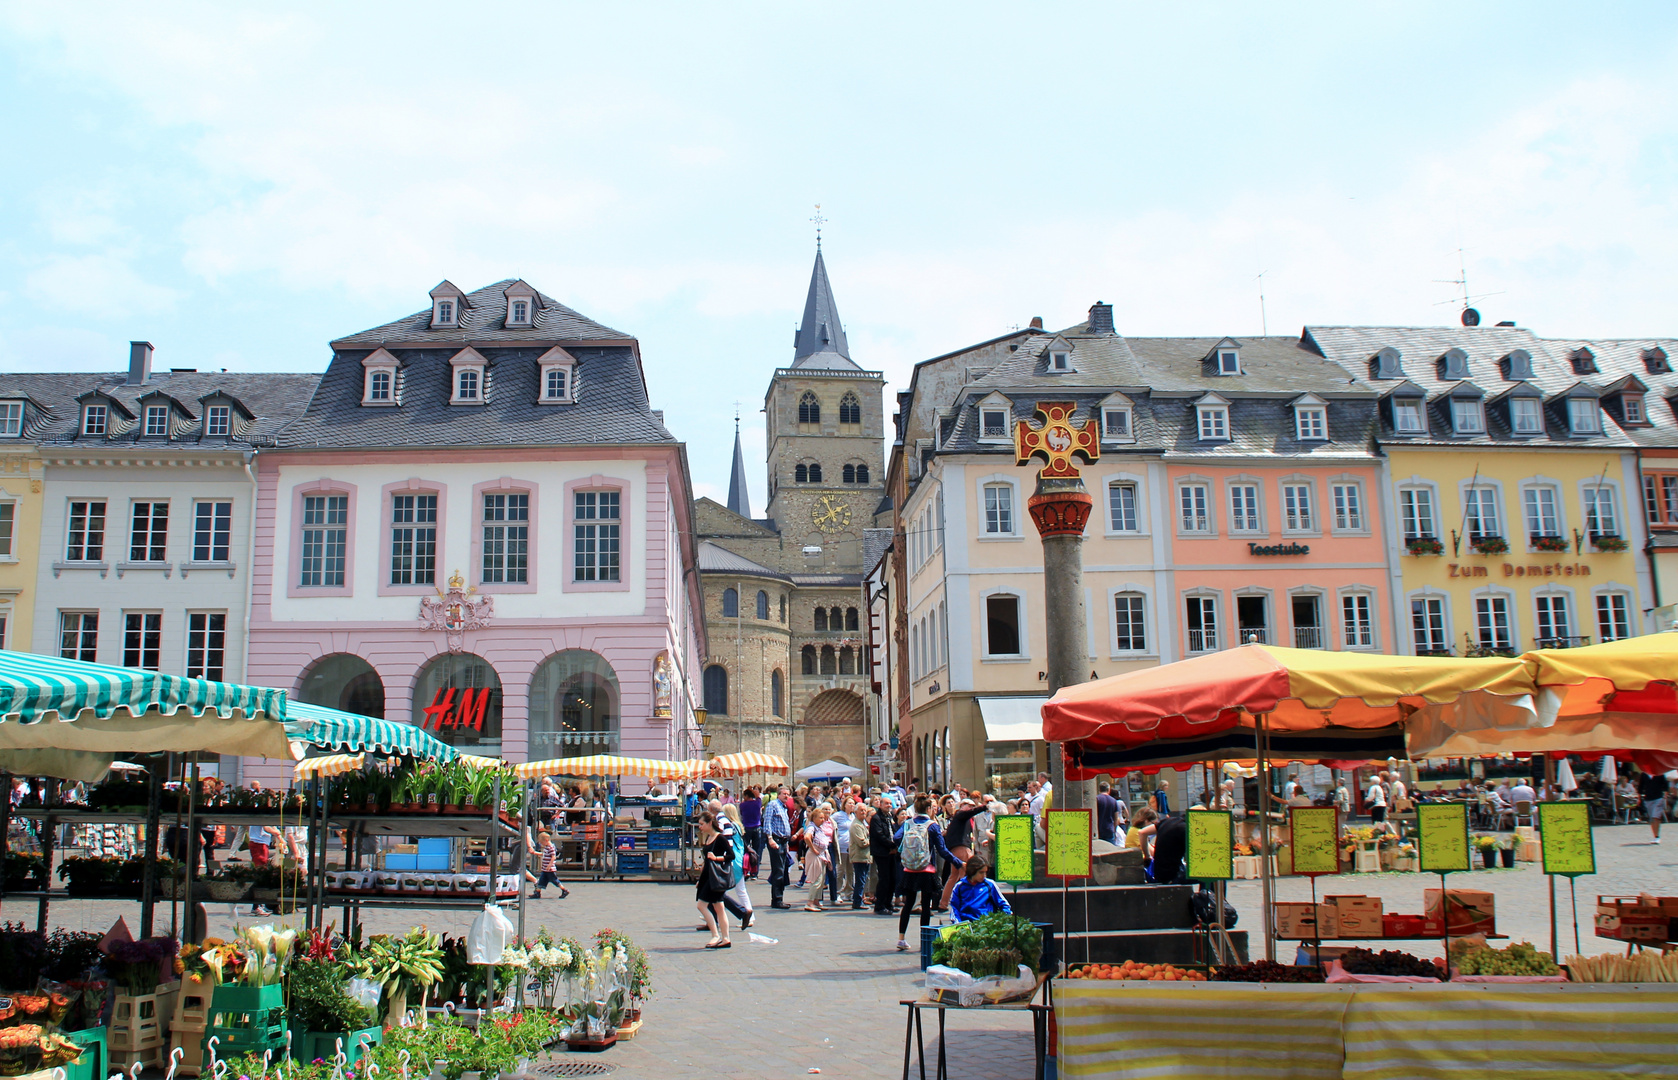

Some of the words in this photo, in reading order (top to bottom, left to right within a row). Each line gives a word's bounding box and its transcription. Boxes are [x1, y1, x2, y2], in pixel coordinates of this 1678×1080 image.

[1247, 541, 1310, 556] Teestube
[1448, 563, 1488, 577] Zum
[1503, 562, 1591, 577] Domstein
[422, 686, 491, 732] H&M
